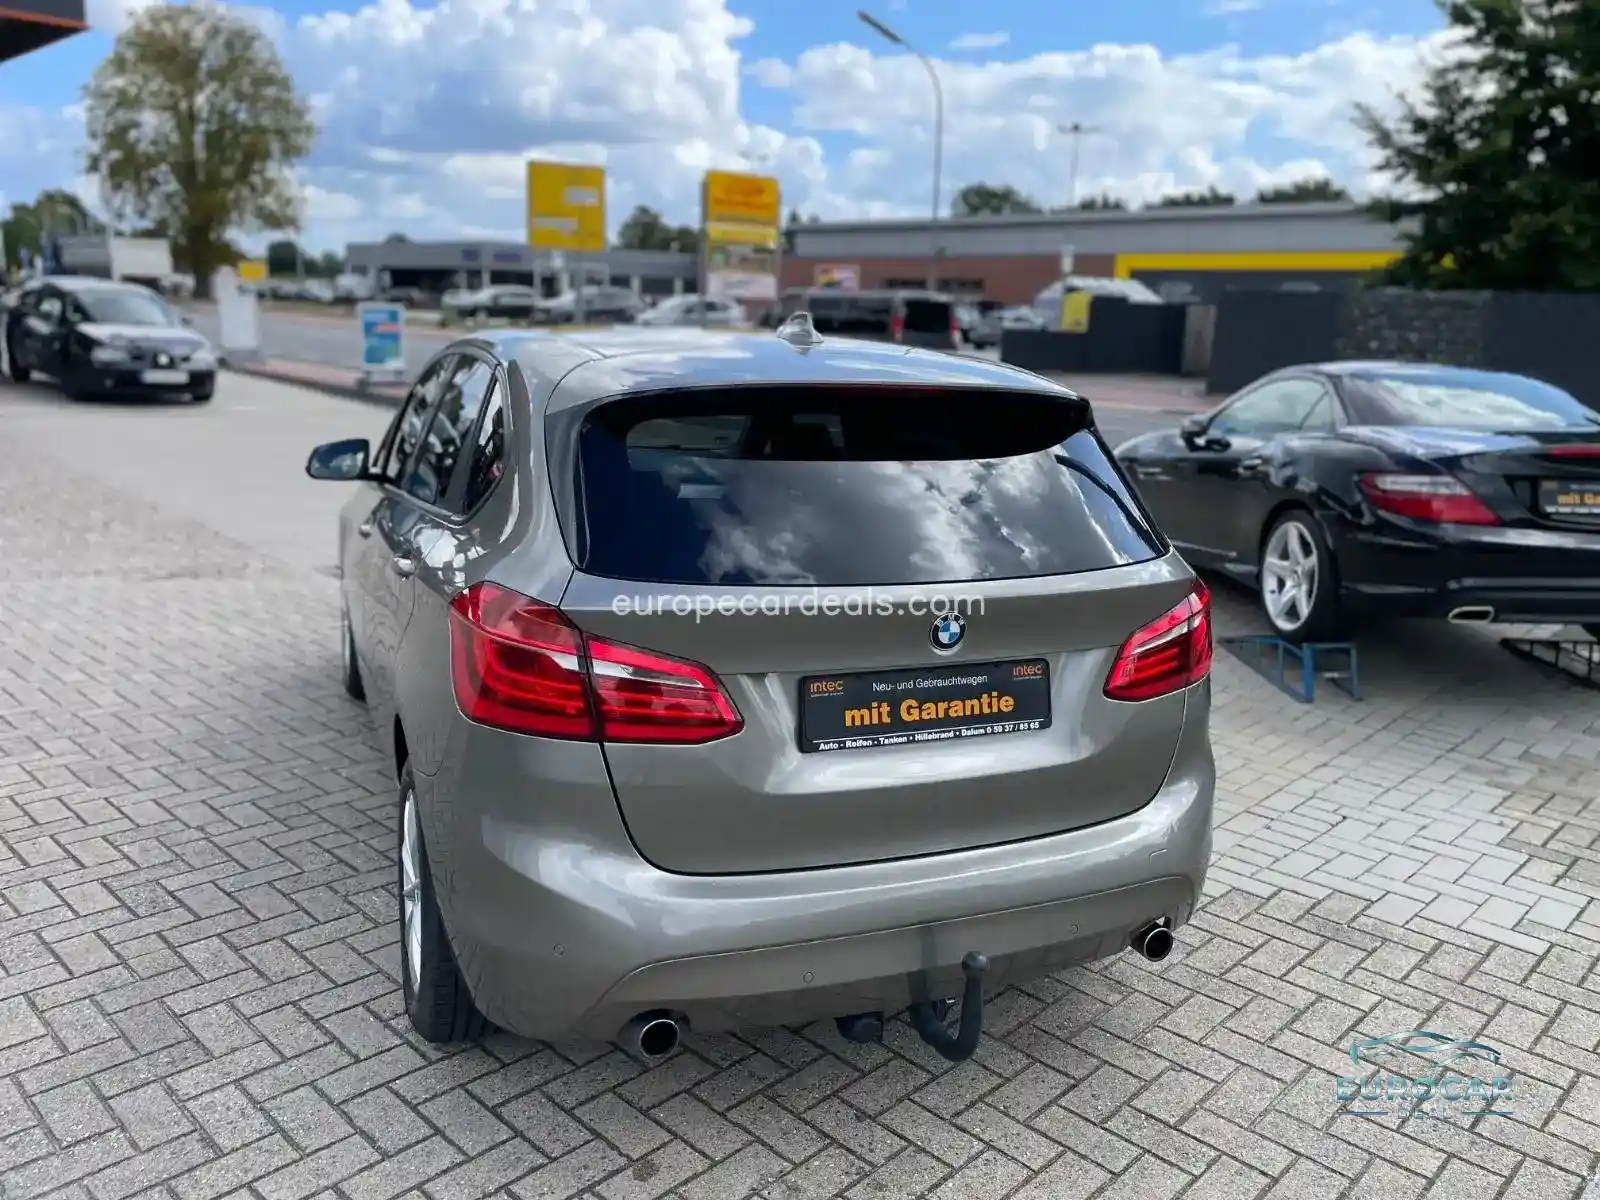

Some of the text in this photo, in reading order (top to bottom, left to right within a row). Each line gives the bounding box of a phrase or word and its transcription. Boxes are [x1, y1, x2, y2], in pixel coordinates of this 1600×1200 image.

[810, 680, 844, 693] intec
[872, 674, 988, 692] Neu- und Gebrauchtwagen
[844, 691, 1015, 727] mit Garantie
[818, 742, 839, 751] Auto
[879, 736, 908, 745] Tanken
[915, 731, 954, 741] Hillebrand
[961, 728, 985, 736] Dalum
[1004, 724, 1014, 732] 37
